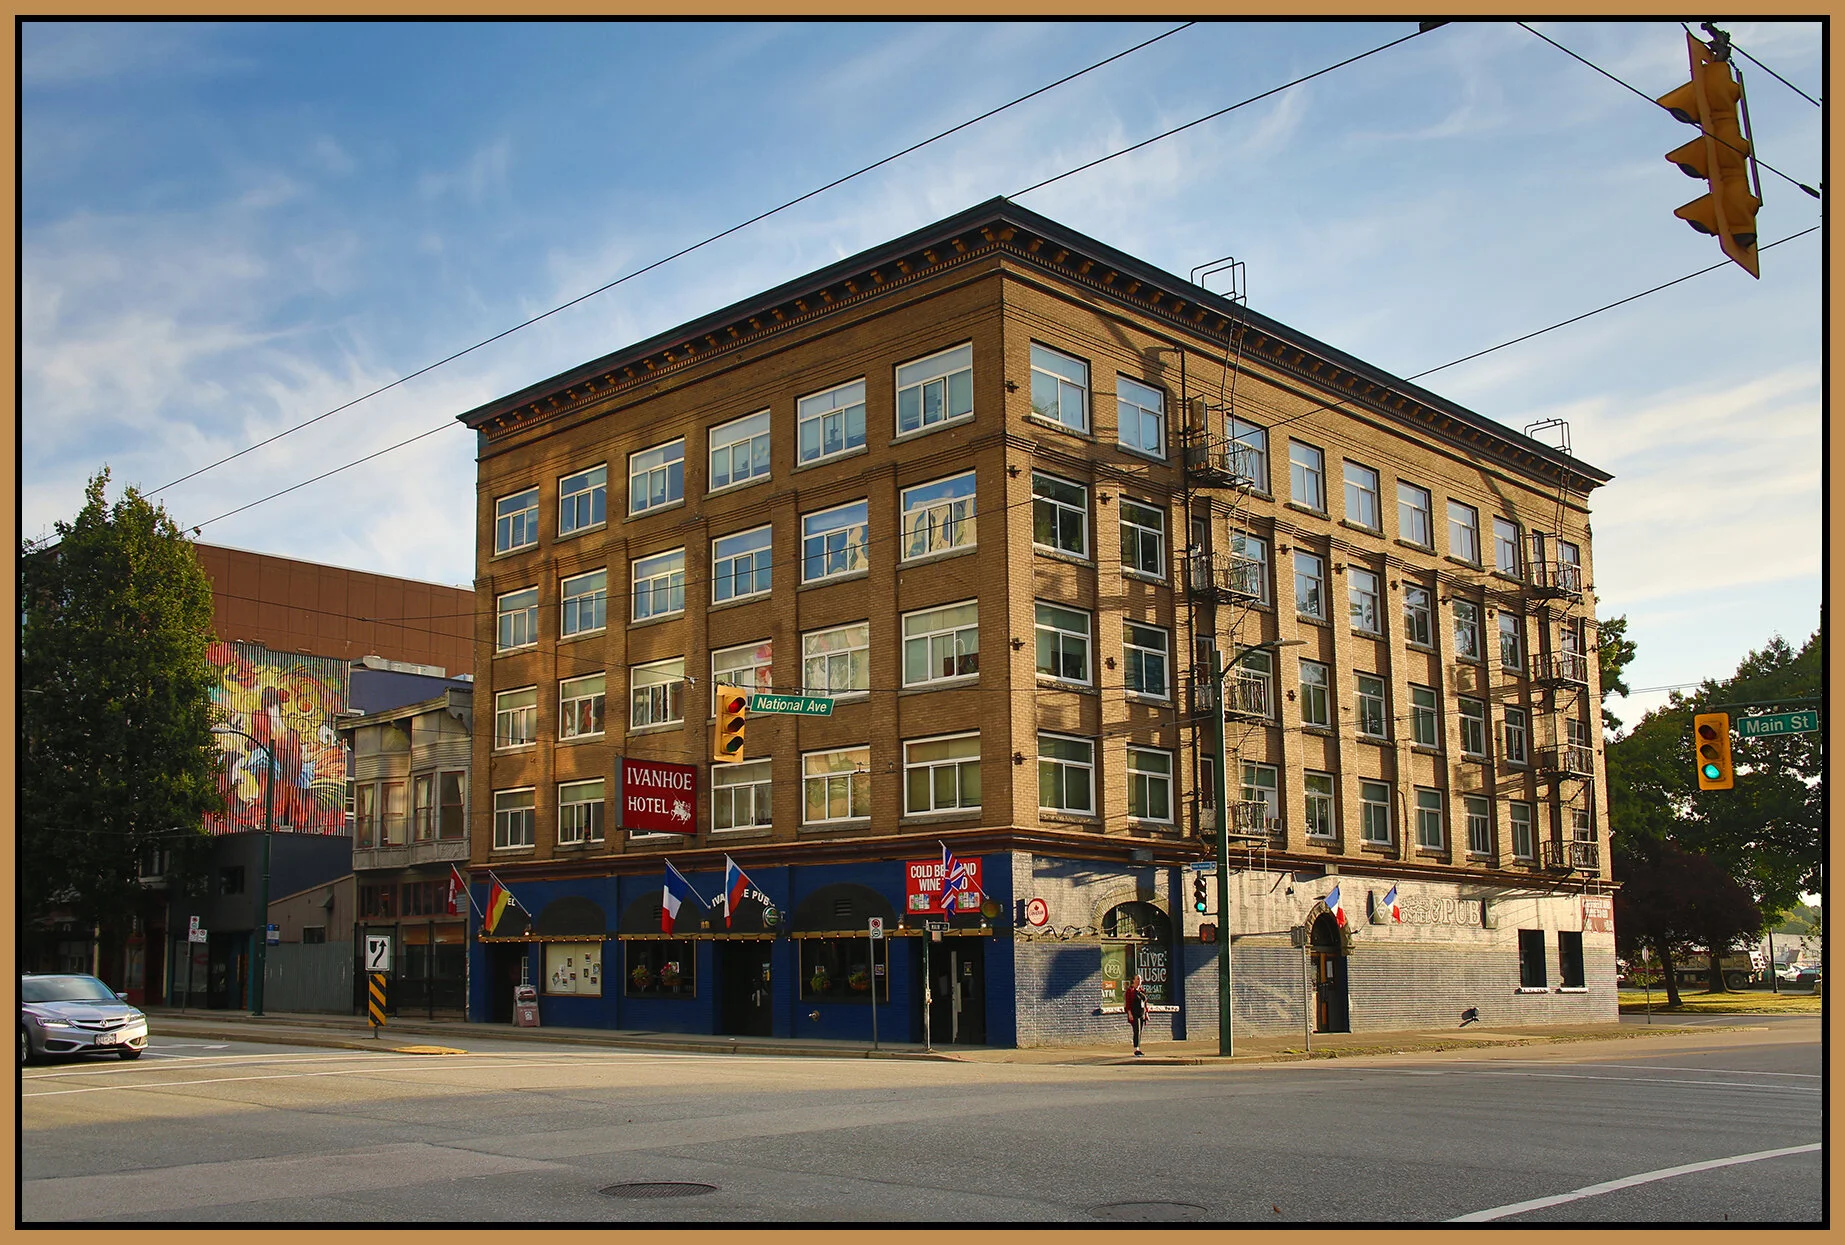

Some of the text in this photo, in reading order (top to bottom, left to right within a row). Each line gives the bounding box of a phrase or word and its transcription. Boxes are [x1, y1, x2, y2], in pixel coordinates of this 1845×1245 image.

[757, 697, 827, 712] National Ave
[1746, 716, 1809, 733] Main St
[627, 767, 692, 790] IVANHOE
[628, 796, 669, 814] HOTEL
[910, 862, 977, 878] COLD BE ND
[919, 878, 941, 891] WINE
[752, 890, 770, 906] PUB
[1441, 898, 1481, 926] PUB
[1139, 952, 1165, 967] LIVE
[1138, 967, 1167, 982] MUSIC
